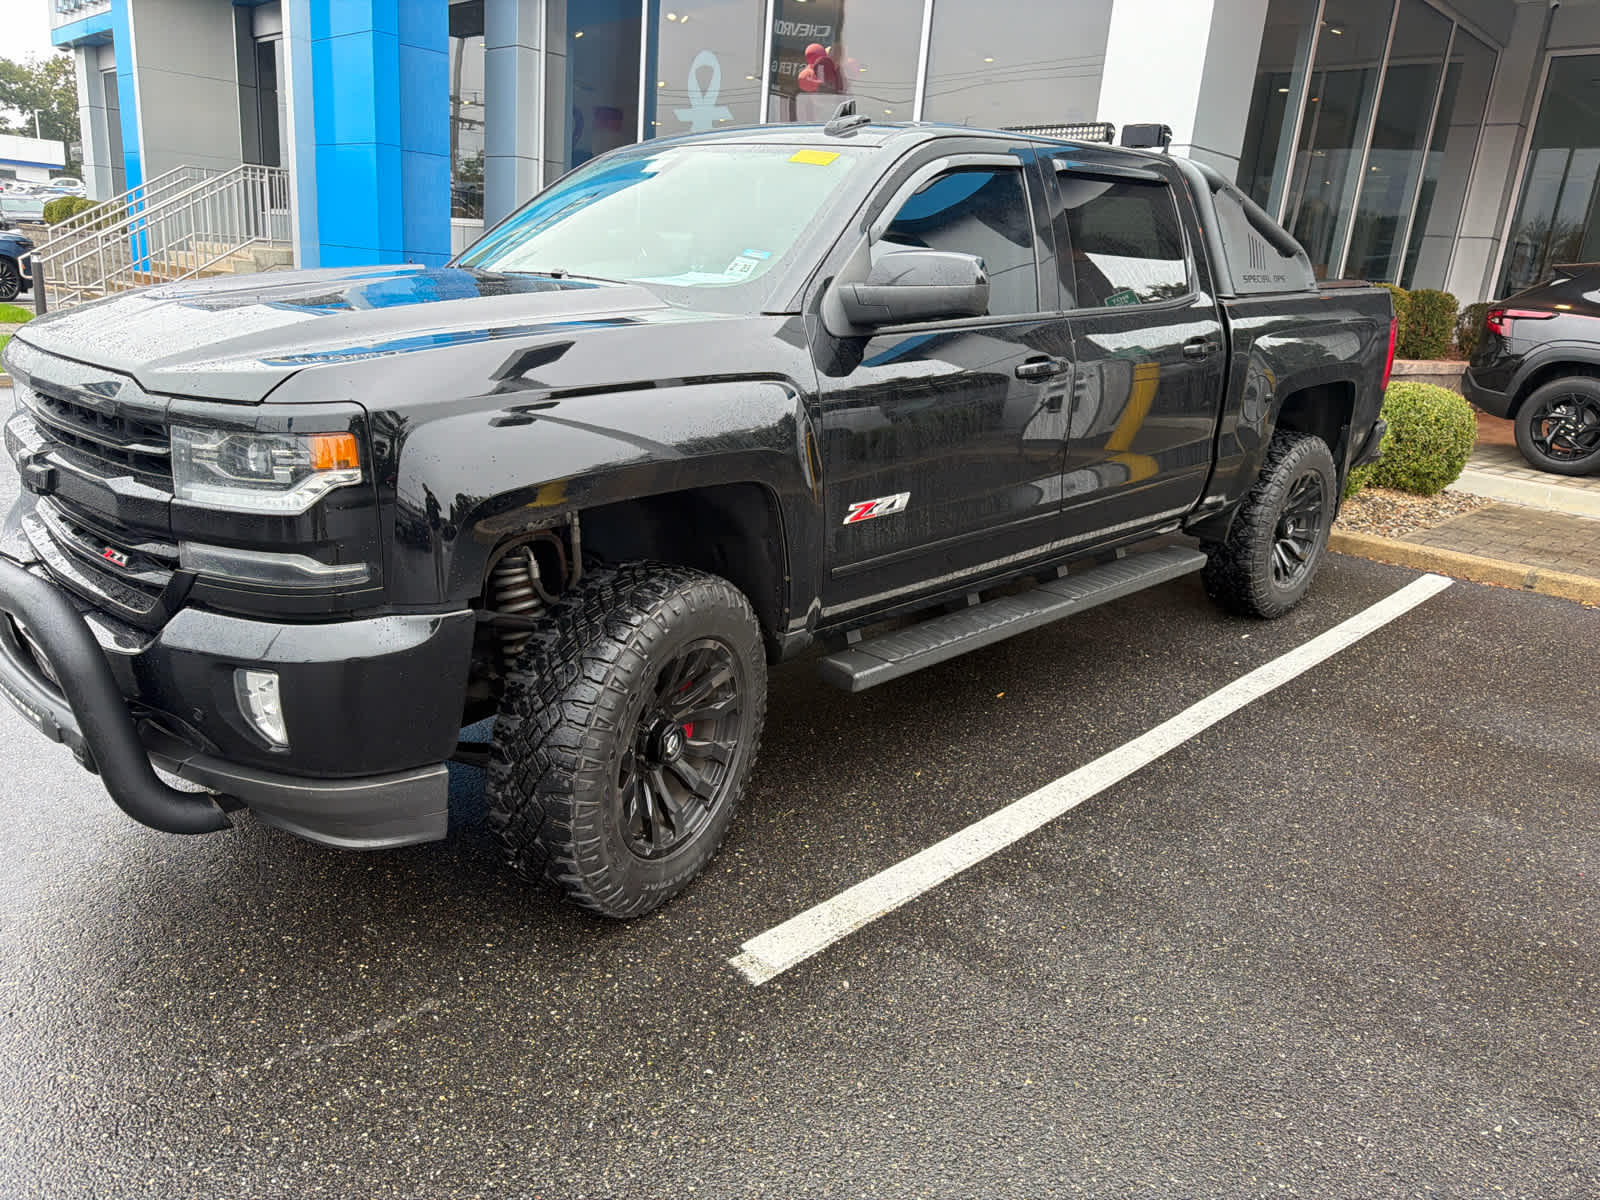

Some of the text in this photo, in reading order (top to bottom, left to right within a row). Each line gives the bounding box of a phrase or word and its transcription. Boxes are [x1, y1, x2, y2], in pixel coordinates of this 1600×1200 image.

[1242, 274, 1271, 284] SPECIAL
[842, 492, 911, 525] Z71
[104, 546, 128, 567] Z71
